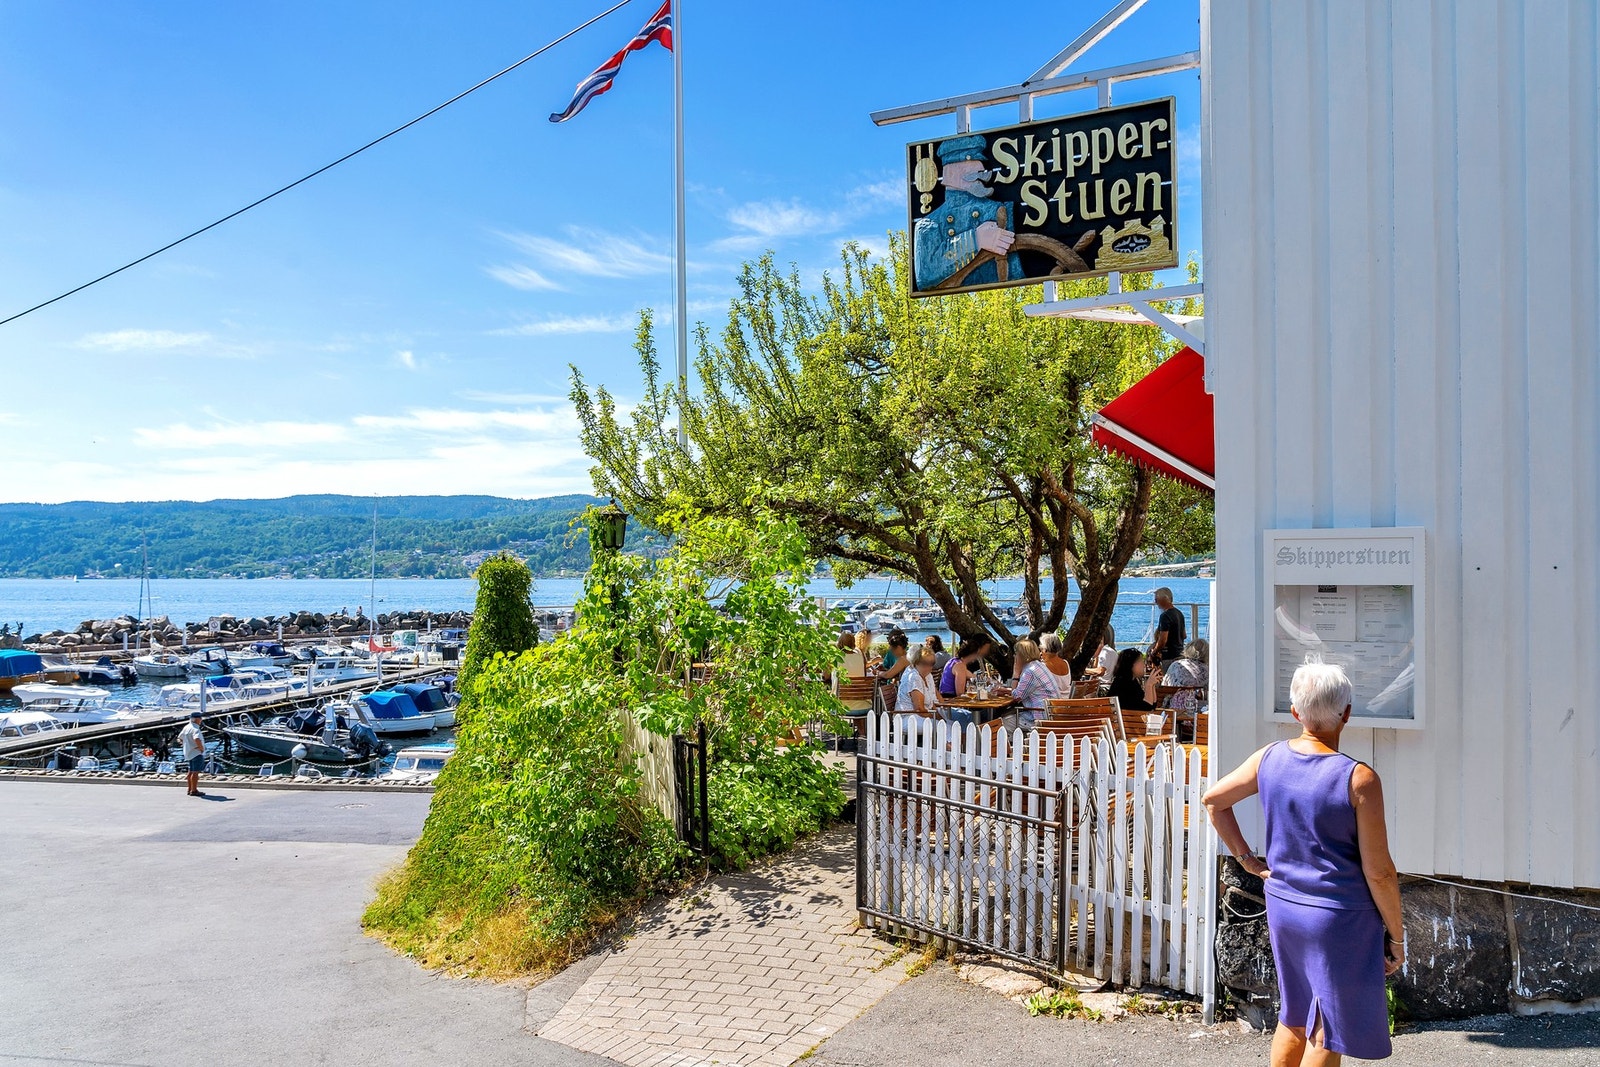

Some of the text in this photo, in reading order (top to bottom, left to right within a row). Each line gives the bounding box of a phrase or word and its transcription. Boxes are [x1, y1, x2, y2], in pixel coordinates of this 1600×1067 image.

[991, 118, 1168, 184] Skipper-
[1020, 170, 1163, 227] Stuen
[1275, 545, 1411, 568] Skipperstuen
